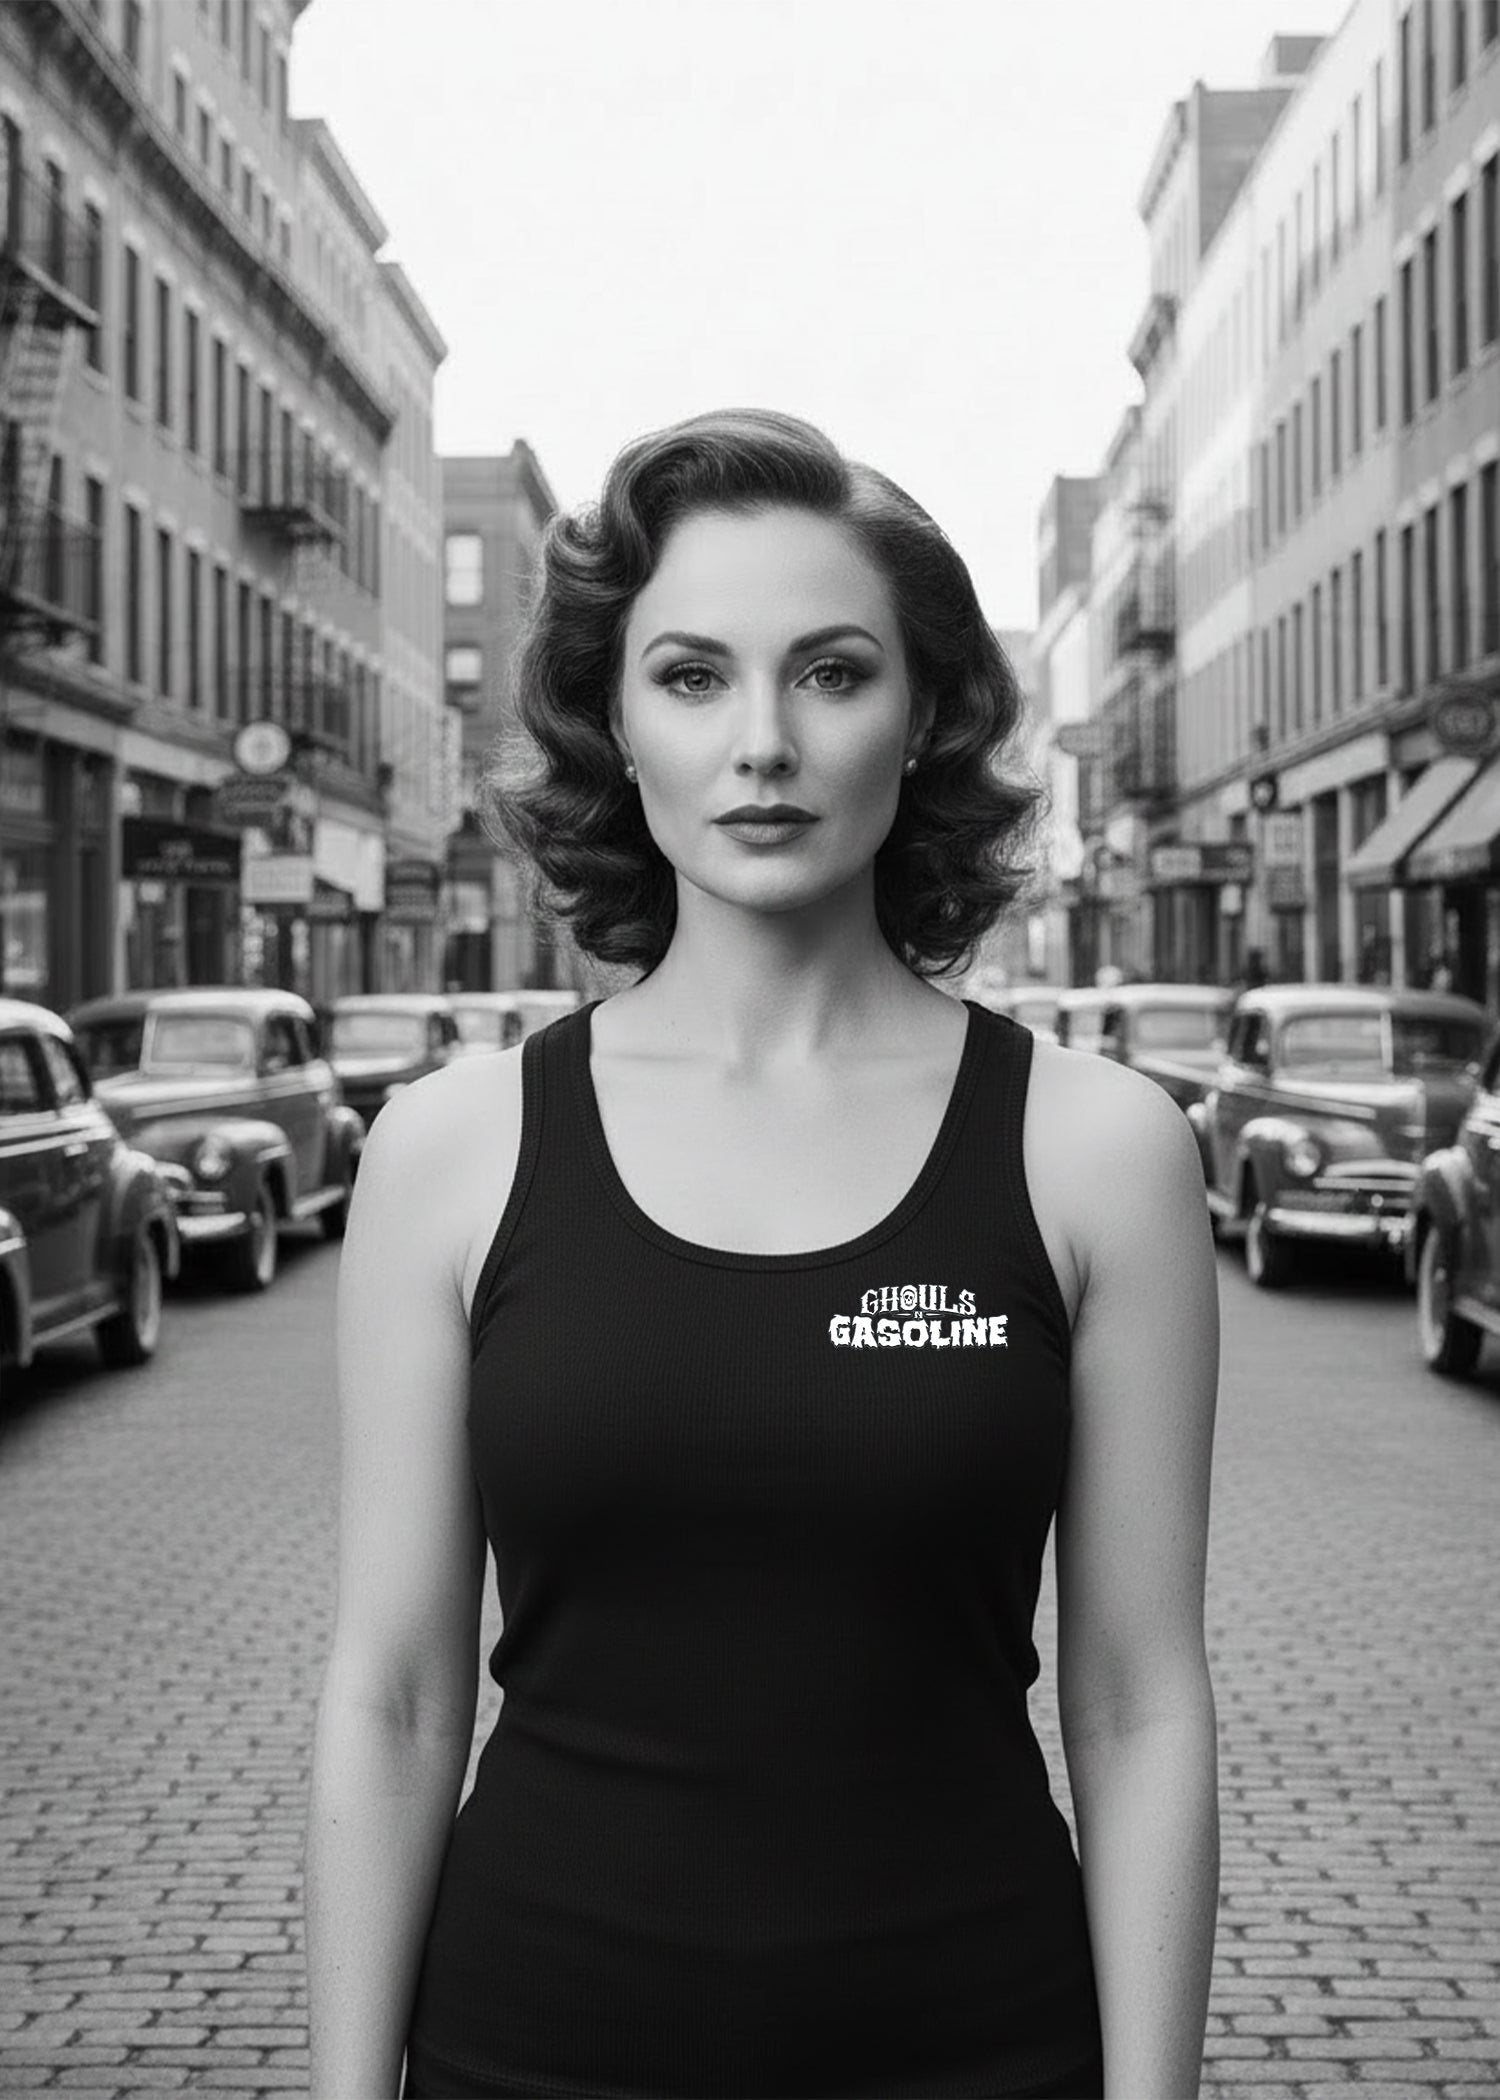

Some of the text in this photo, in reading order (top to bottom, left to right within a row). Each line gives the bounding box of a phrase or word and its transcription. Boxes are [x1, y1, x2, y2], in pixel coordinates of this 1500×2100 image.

[860, 1284, 977, 1315] GHOULS
[914, 1310, 923, 1319] N
[828, 1314, 1009, 1349] GASOLINE
